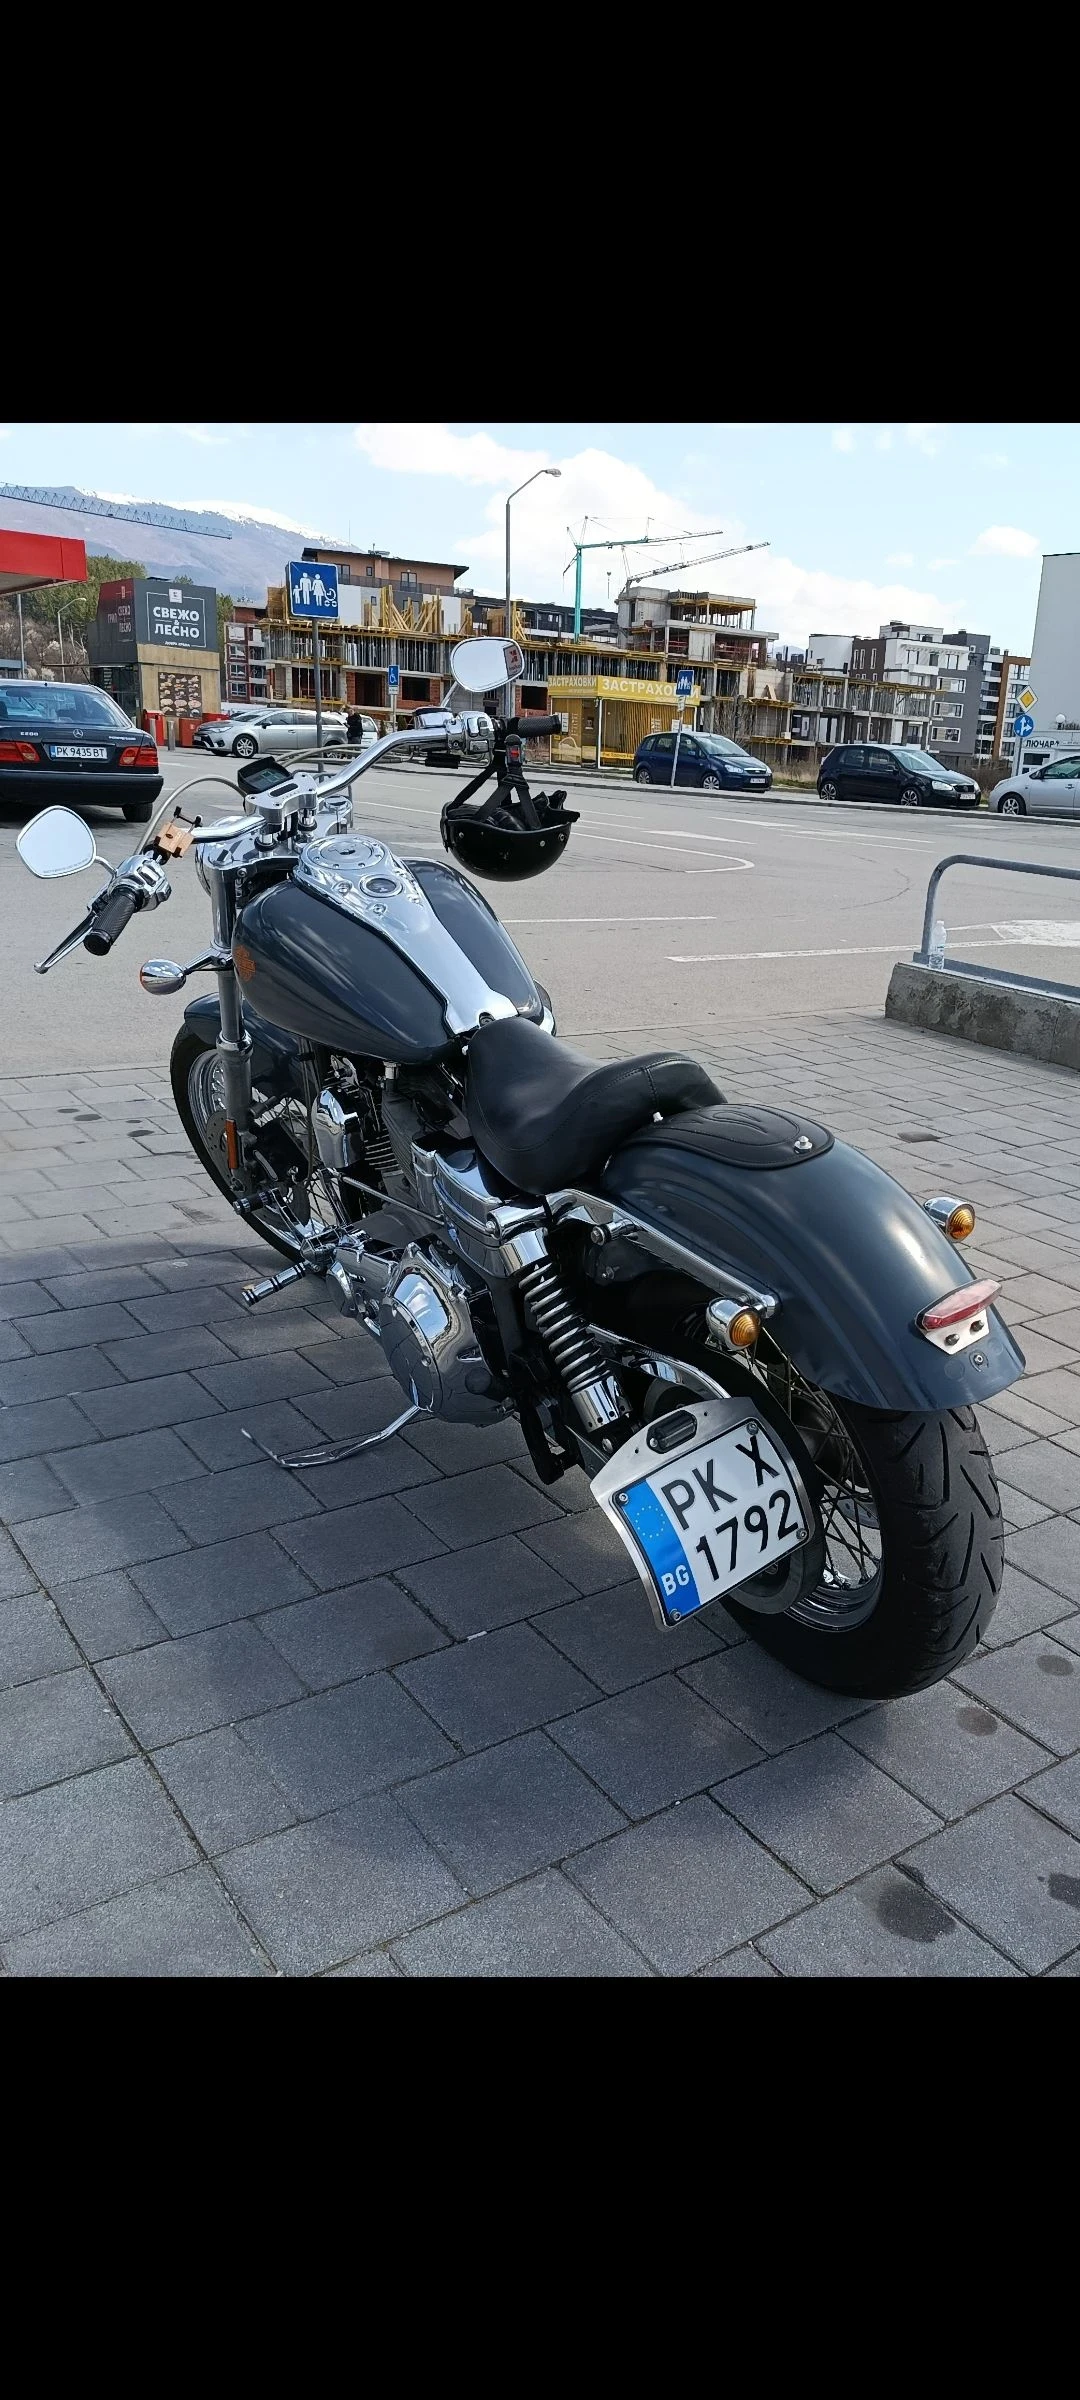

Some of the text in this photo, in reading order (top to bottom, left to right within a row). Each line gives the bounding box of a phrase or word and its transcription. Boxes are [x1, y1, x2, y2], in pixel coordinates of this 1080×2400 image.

[152, 606, 200, 621] СВЕЖО
[154, 623, 200, 639] ЛЕСНО
[548, 676, 597, 688] ЗАСТРАХОВКИ
[602, 678, 700, 699] ЗАСТРАХОИ
[56, 746, 105, 758] PK 9435 BT
[660, 1435, 780, 1531] PK X
[695, 1489, 800, 1582] 1792
[660, 1564, 690, 1597] BG
